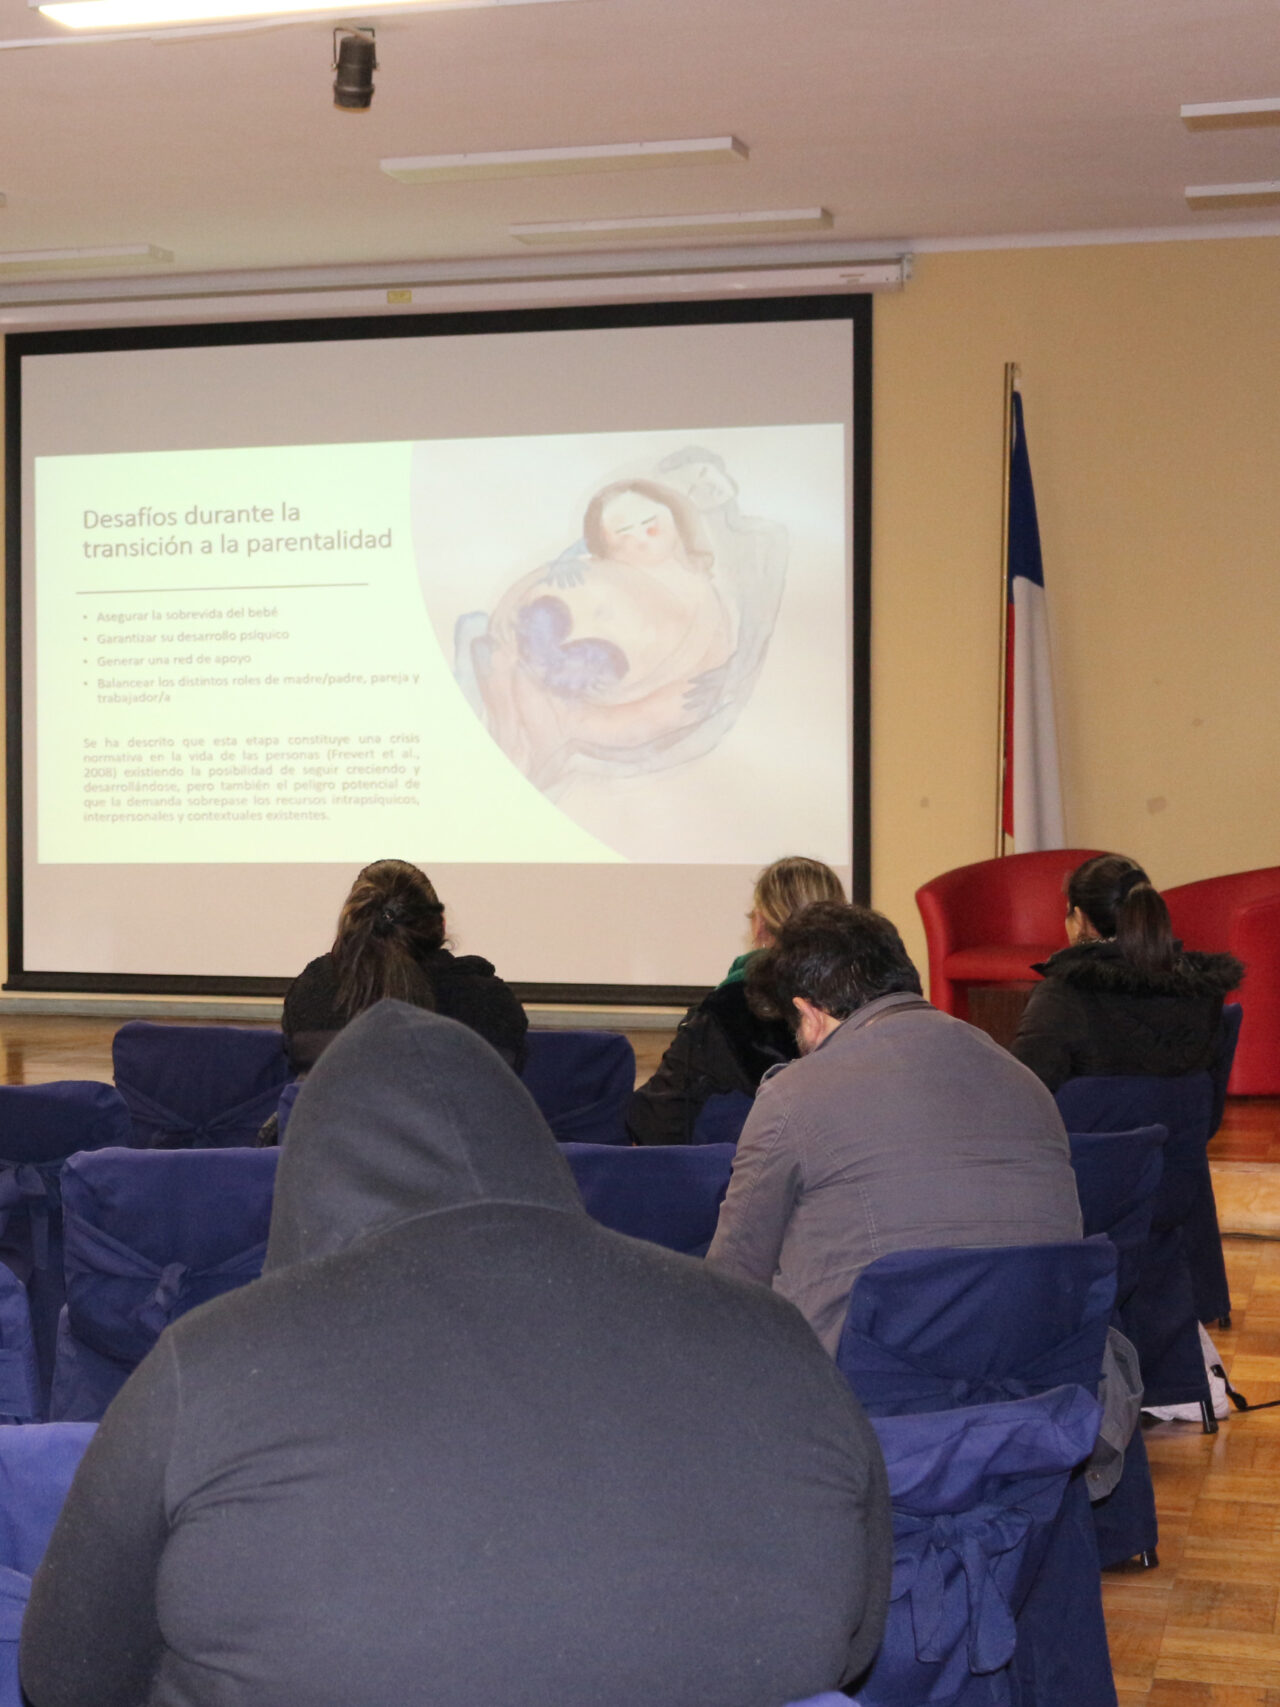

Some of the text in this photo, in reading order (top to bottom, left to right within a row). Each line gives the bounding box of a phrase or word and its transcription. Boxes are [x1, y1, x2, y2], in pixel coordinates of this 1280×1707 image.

[83, 502, 301, 529] Desafíos durante la
[83, 528, 392, 559] transición a la parentalidad
[96, 607, 278, 624] Asegurar la sobrevida del bebé
[97, 630, 290, 644] Garantizar su desarrollo psíquico
[97, 654, 252, 666] Generar una red de apoyo
[98, 672, 420, 689] Balancear los distintos roles de madre/padre, pareja y
[97, 691, 171, 705] trabajador/a
[83, 733, 420, 748] Se ha descrito que esta etapa constituye una crisis
[83, 752, 143, 763] normativa
[171, 752, 182, 761] la
[189, 751, 213, 761] vida
[220, 751, 236, 760] de
[242, 750, 258, 760] las
[266, 751, 320, 762] personas
[327, 749, 375, 761] (Frevert
[382, 750, 394, 759] et
[84, 764, 420, 778] 2008) existiendo la posibilidad de seguir creciendo y
[84, 778, 420, 793] desarrollándose, pero también el peligro potencial de
[84, 794, 420, 809] que la demanda sobrepase los recursos intrapsíquicos,
[83, 810, 331, 823] interpersonales y contextuales existentes.
